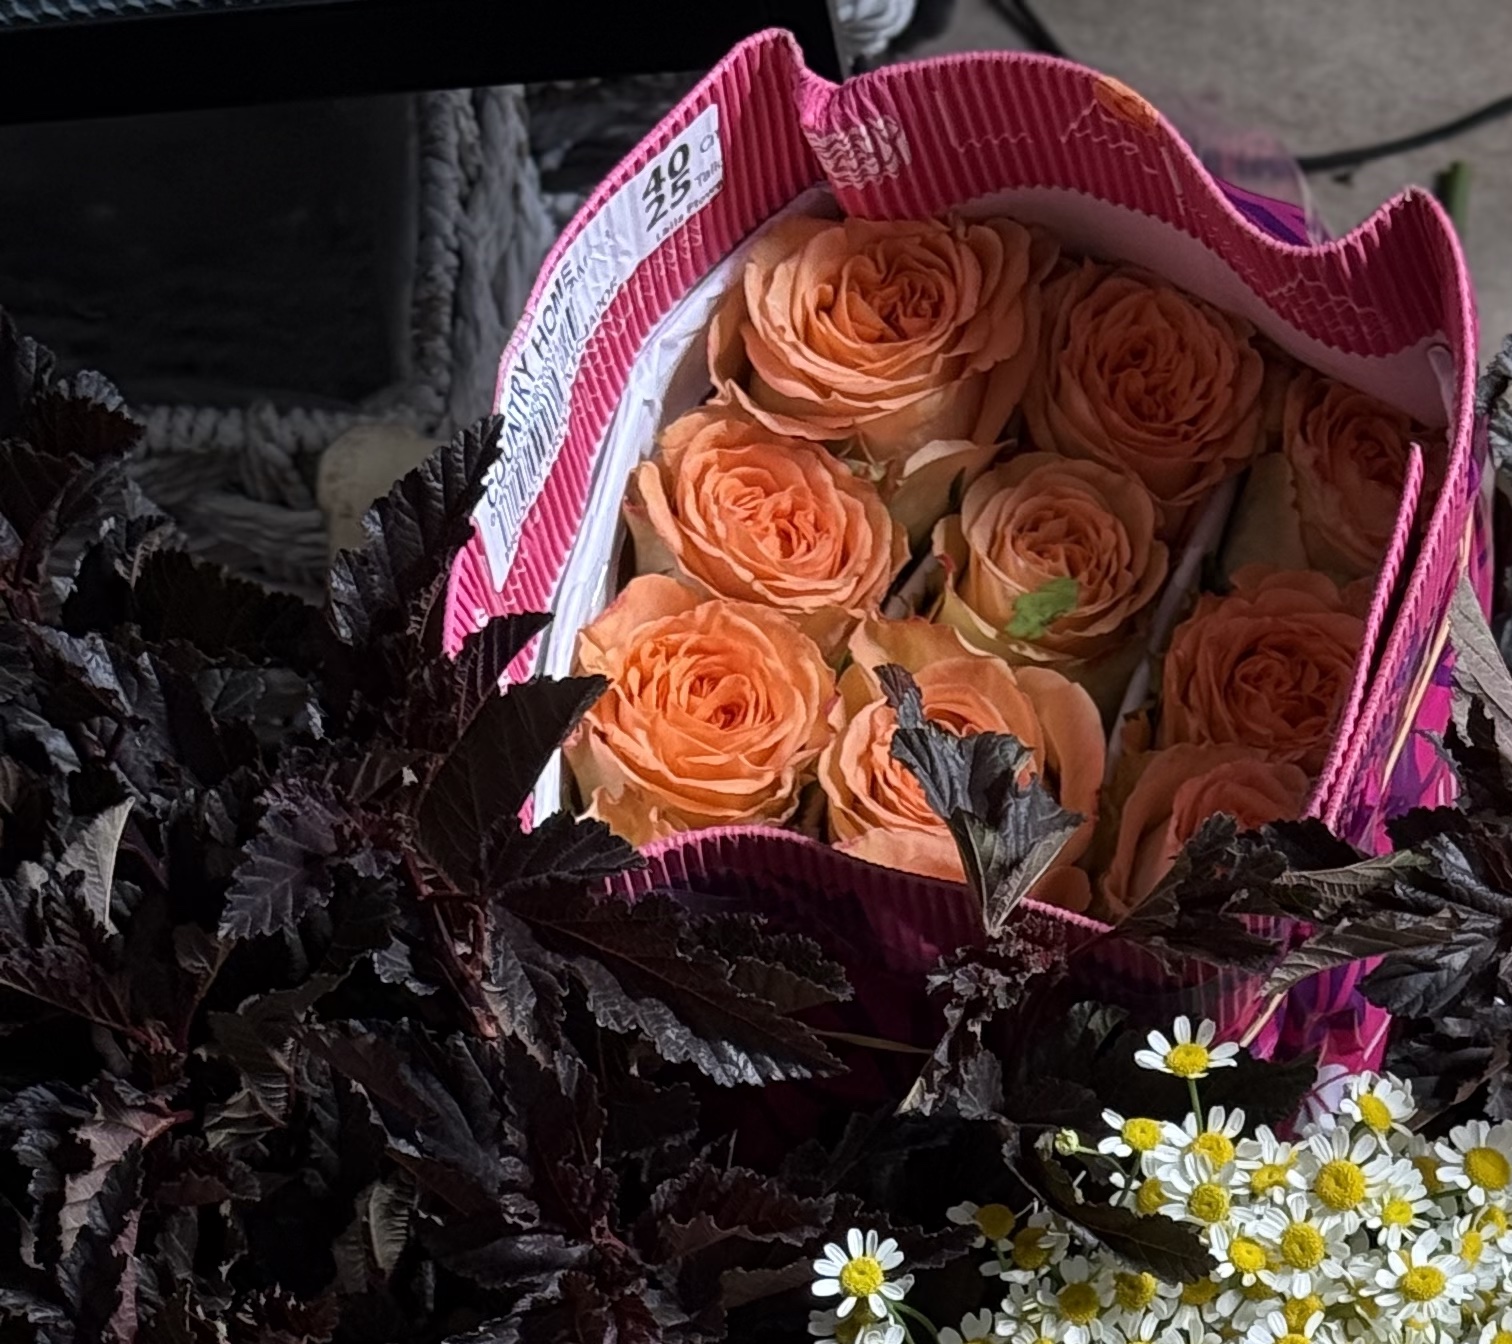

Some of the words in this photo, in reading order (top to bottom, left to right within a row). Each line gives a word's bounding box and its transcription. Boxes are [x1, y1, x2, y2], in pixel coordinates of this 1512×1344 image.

[642, 142, 690, 201] 40
[645, 168, 691, 232] 25
[486, 352, 536, 508] COUNTRY
